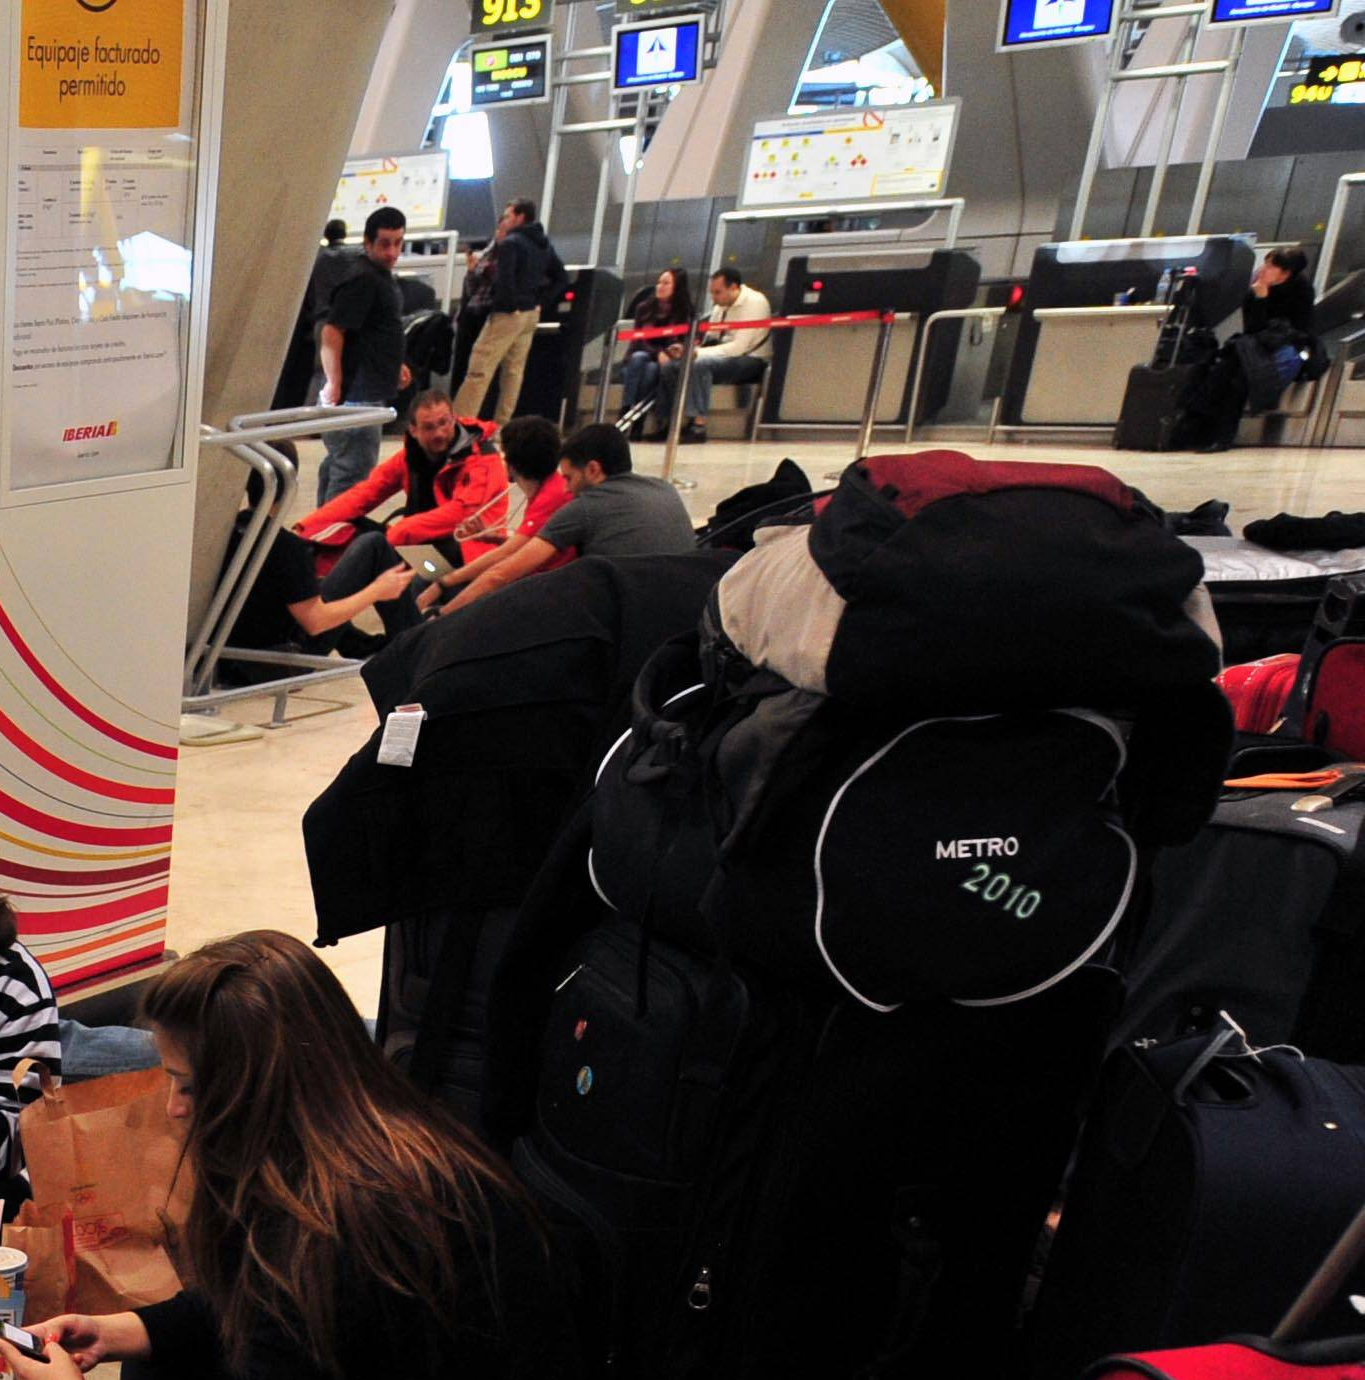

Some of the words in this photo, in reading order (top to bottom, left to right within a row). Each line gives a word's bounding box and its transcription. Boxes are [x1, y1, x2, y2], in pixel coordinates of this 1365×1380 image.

[482, 0, 541, 25] 913
[27, 36, 90, 69] Equipaje
[94, 36, 161, 64] facturado
[59, 71, 126, 104] permitido
[62, 425, 106, 442] IBERIA
[936, 836, 1019, 860] METRO
[961, 862, 1042, 919] 2010
